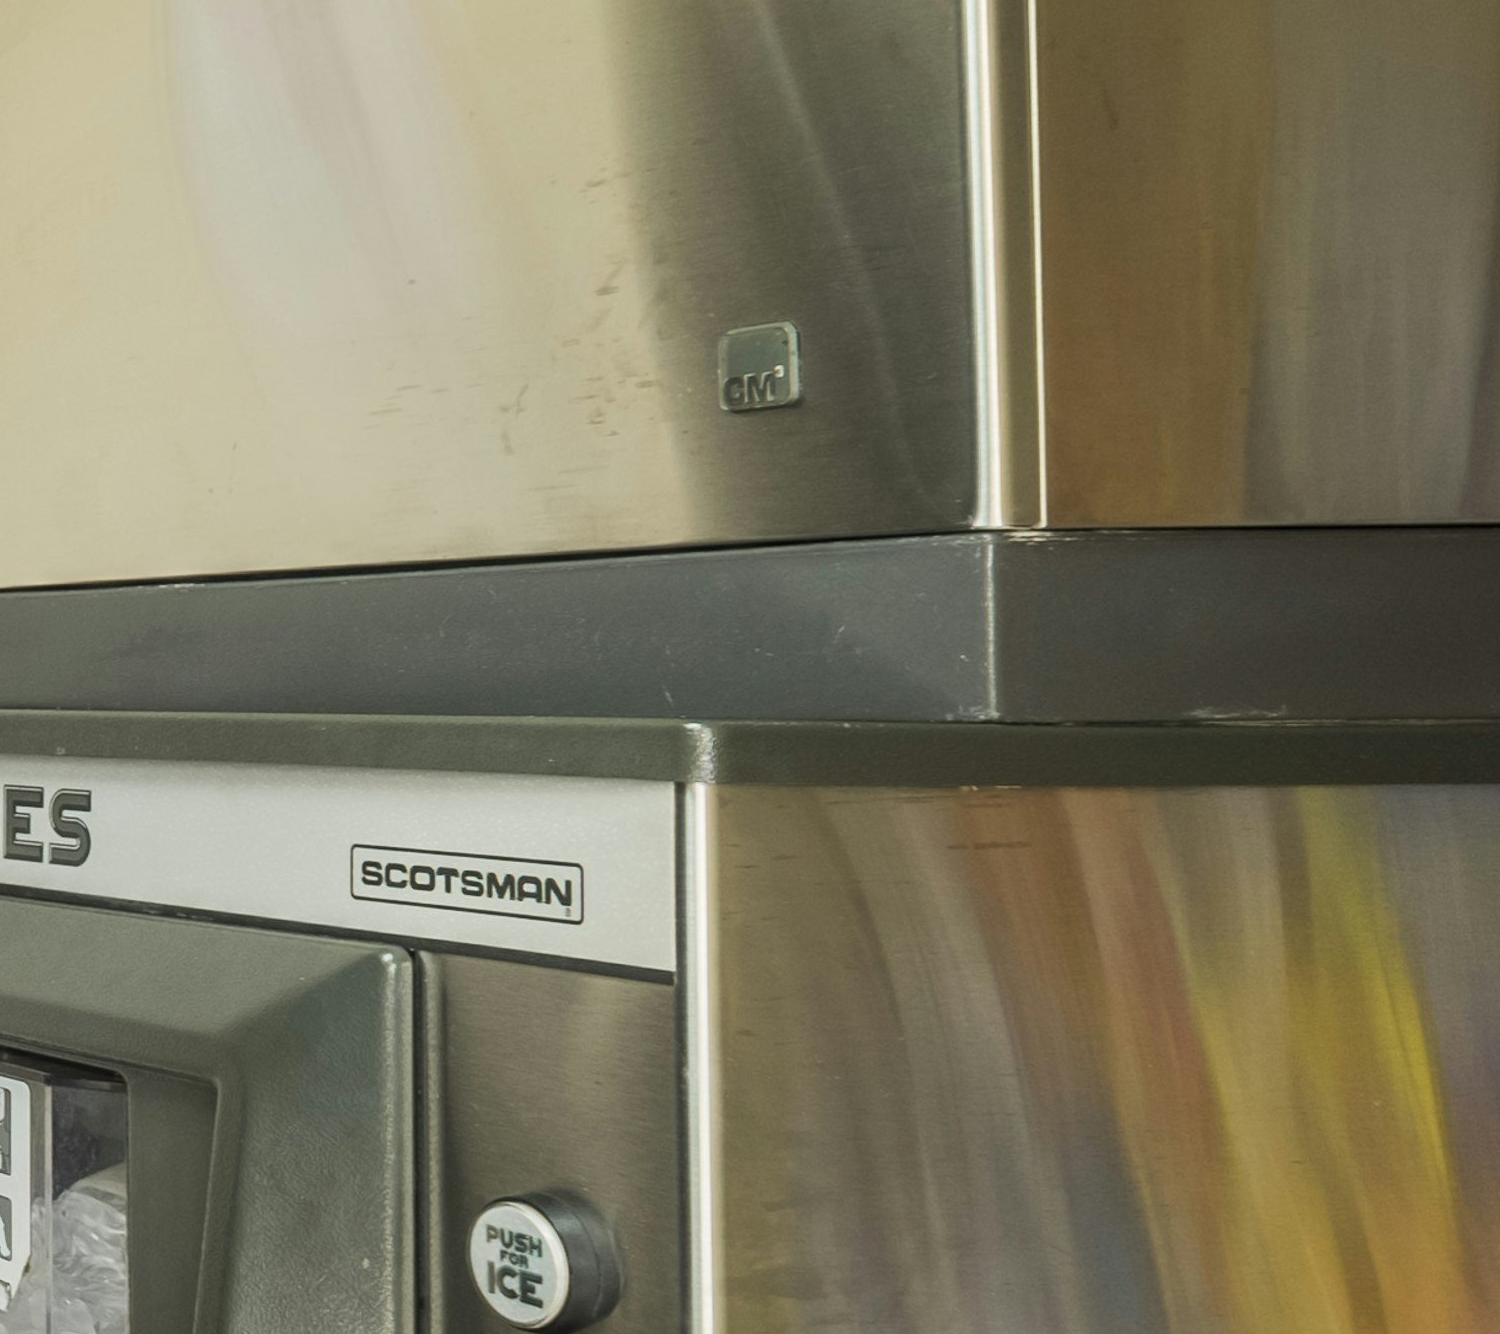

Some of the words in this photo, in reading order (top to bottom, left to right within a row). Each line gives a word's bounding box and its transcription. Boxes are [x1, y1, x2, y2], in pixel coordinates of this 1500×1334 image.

[361, 860, 573, 909] SCOTSMAN
[485, 1223, 544, 1258] PUSH
[499, 1249, 529, 1269] FOR
[486, 1260, 544, 1309] ICE
